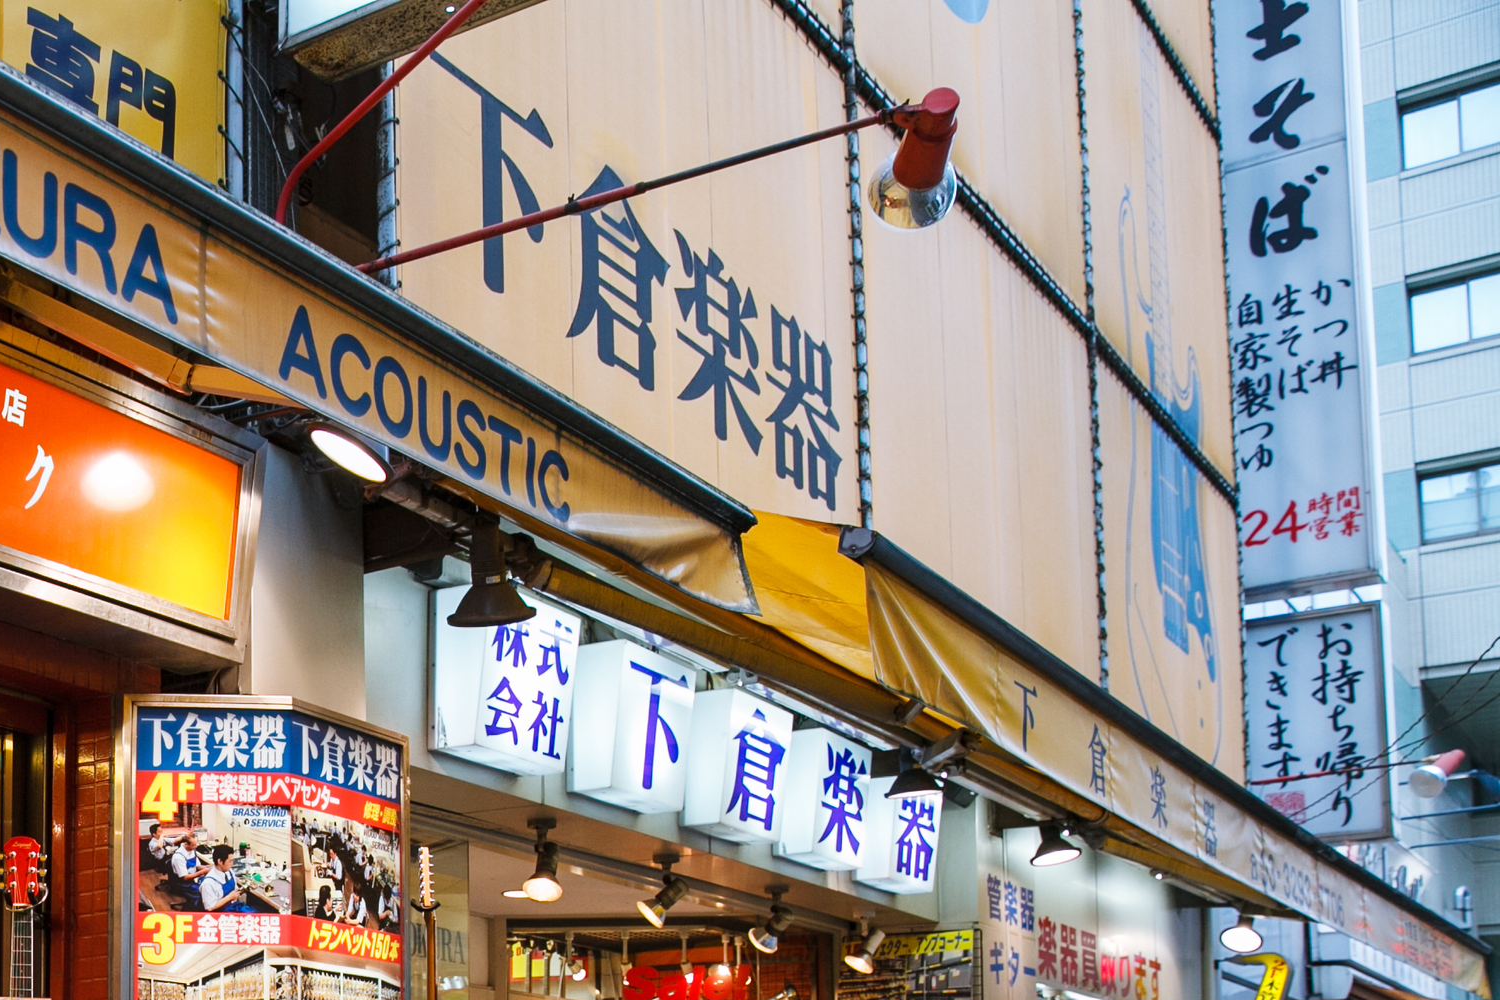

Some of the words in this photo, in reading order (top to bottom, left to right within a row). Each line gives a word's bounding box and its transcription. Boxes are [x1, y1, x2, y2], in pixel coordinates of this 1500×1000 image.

[25, 5, 177, 159] 専門
[430, 50, 845, 512] 下倉楽器
[1271, 284, 1313, 400] 生そば
[1310, 278, 1359, 391] かつ丼
[278, 304, 571, 524] ACOUSTIC
[1232, 292, 1276, 472] 自家製つゆ
[1243, 500, 1308, 548] 24
[490, 620, 573, 686] 株式
[141, 711, 288, 770] 下倉楽器
[484, 676, 565, 761] 会社
[1256, 627, 1302, 791] できます
[1311, 621, 1366, 829] お持ち帰り
[140, 772, 196, 823] 4F
[199, 772, 341, 811] 管楽器リペアセンター
[292, 719, 399, 800] 下倉楽器
[629, 659, 936, 882] 下倉楽器
[1012, 679, 1218, 861] 下倉楽器
[231, 807, 262, 818] BRASS
[263, 807, 287, 819] WIND
[250, 818, 288, 829] SERVICE
[140, 912, 194, 965] 3F
[196, 914, 281, 945] 金管楽器
[307, 920, 400, 963] トランペット150本
[986, 873, 1035, 933] 管楽器
[989, 941, 1037, 987] ギター
